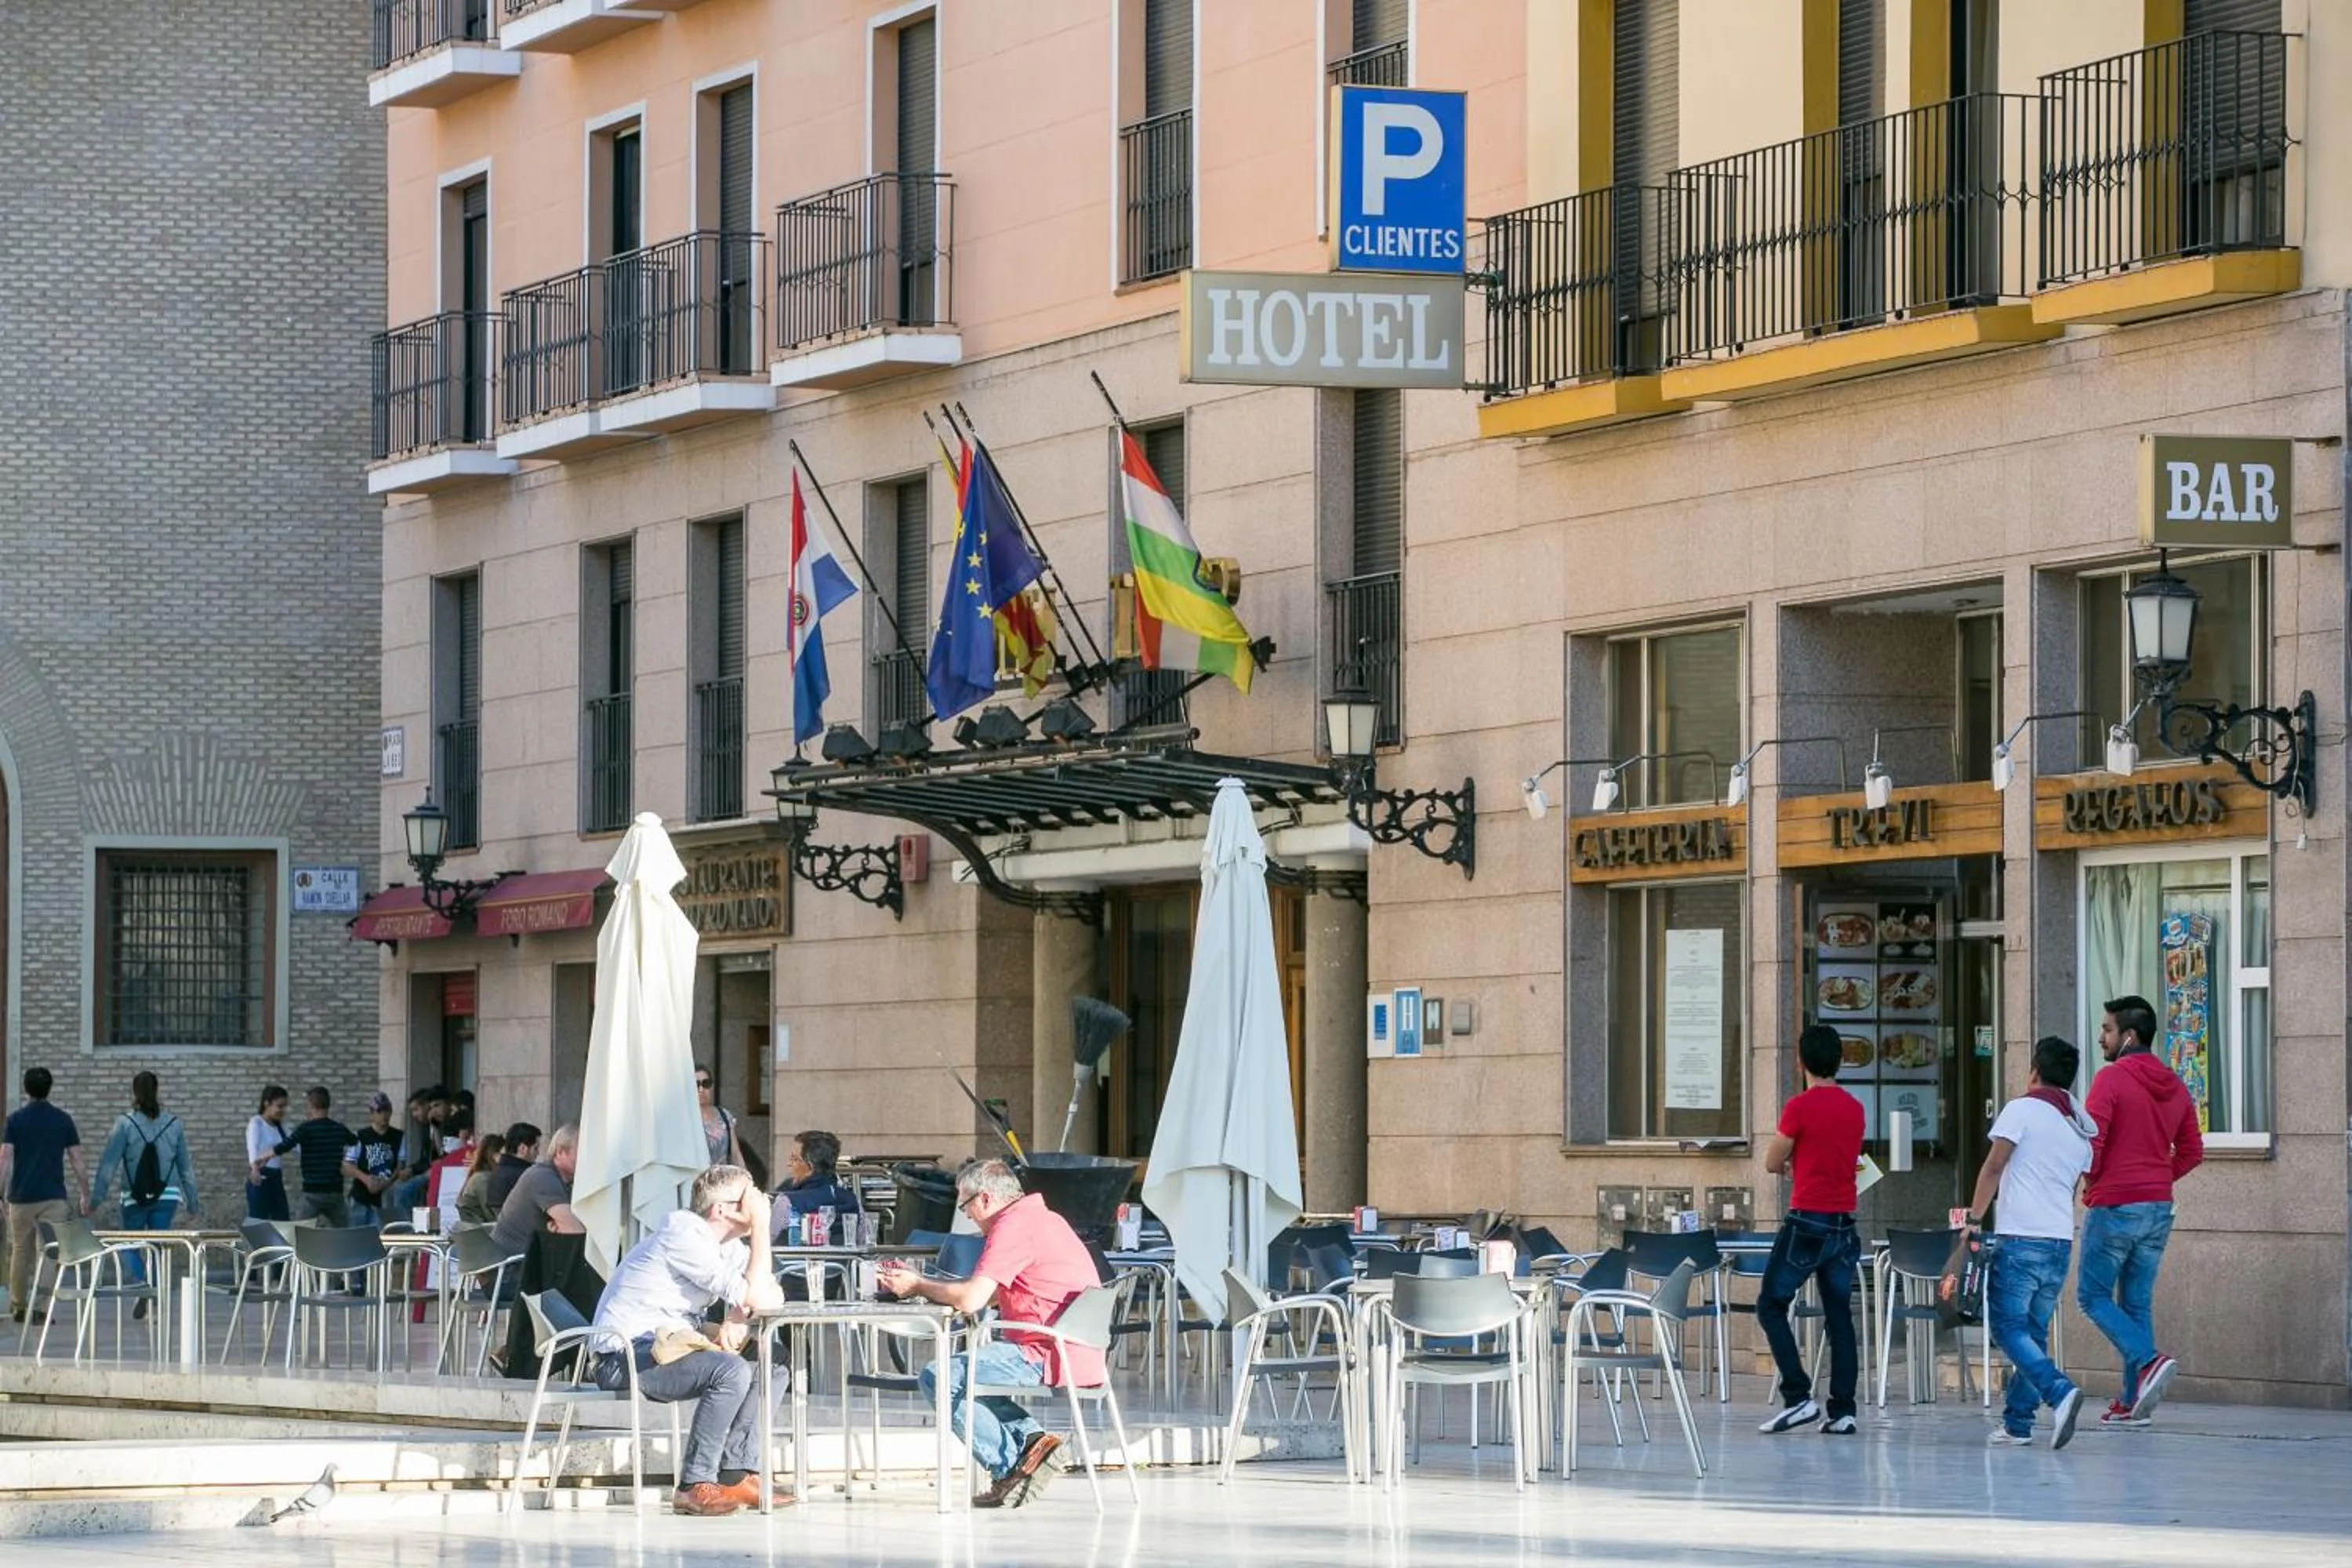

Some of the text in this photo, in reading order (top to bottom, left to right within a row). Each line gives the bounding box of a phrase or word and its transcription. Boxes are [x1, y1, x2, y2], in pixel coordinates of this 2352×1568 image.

[1362, 101, 1444, 216] P
[1344, 224, 1461, 260] CLIENTES
[1207, 288, 1449, 371] HOTEL
[2166, 461, 2279, 524] BAR
[1826, 798, 1936, 850] TREVI
[2063, 777, 2225, 833] REGALOS
[1574, 816, 1734, 868] CAFETERIA
[321, 872, 349, 884] CALLE
[499, 902, 570, 931] FORO ROMANO
